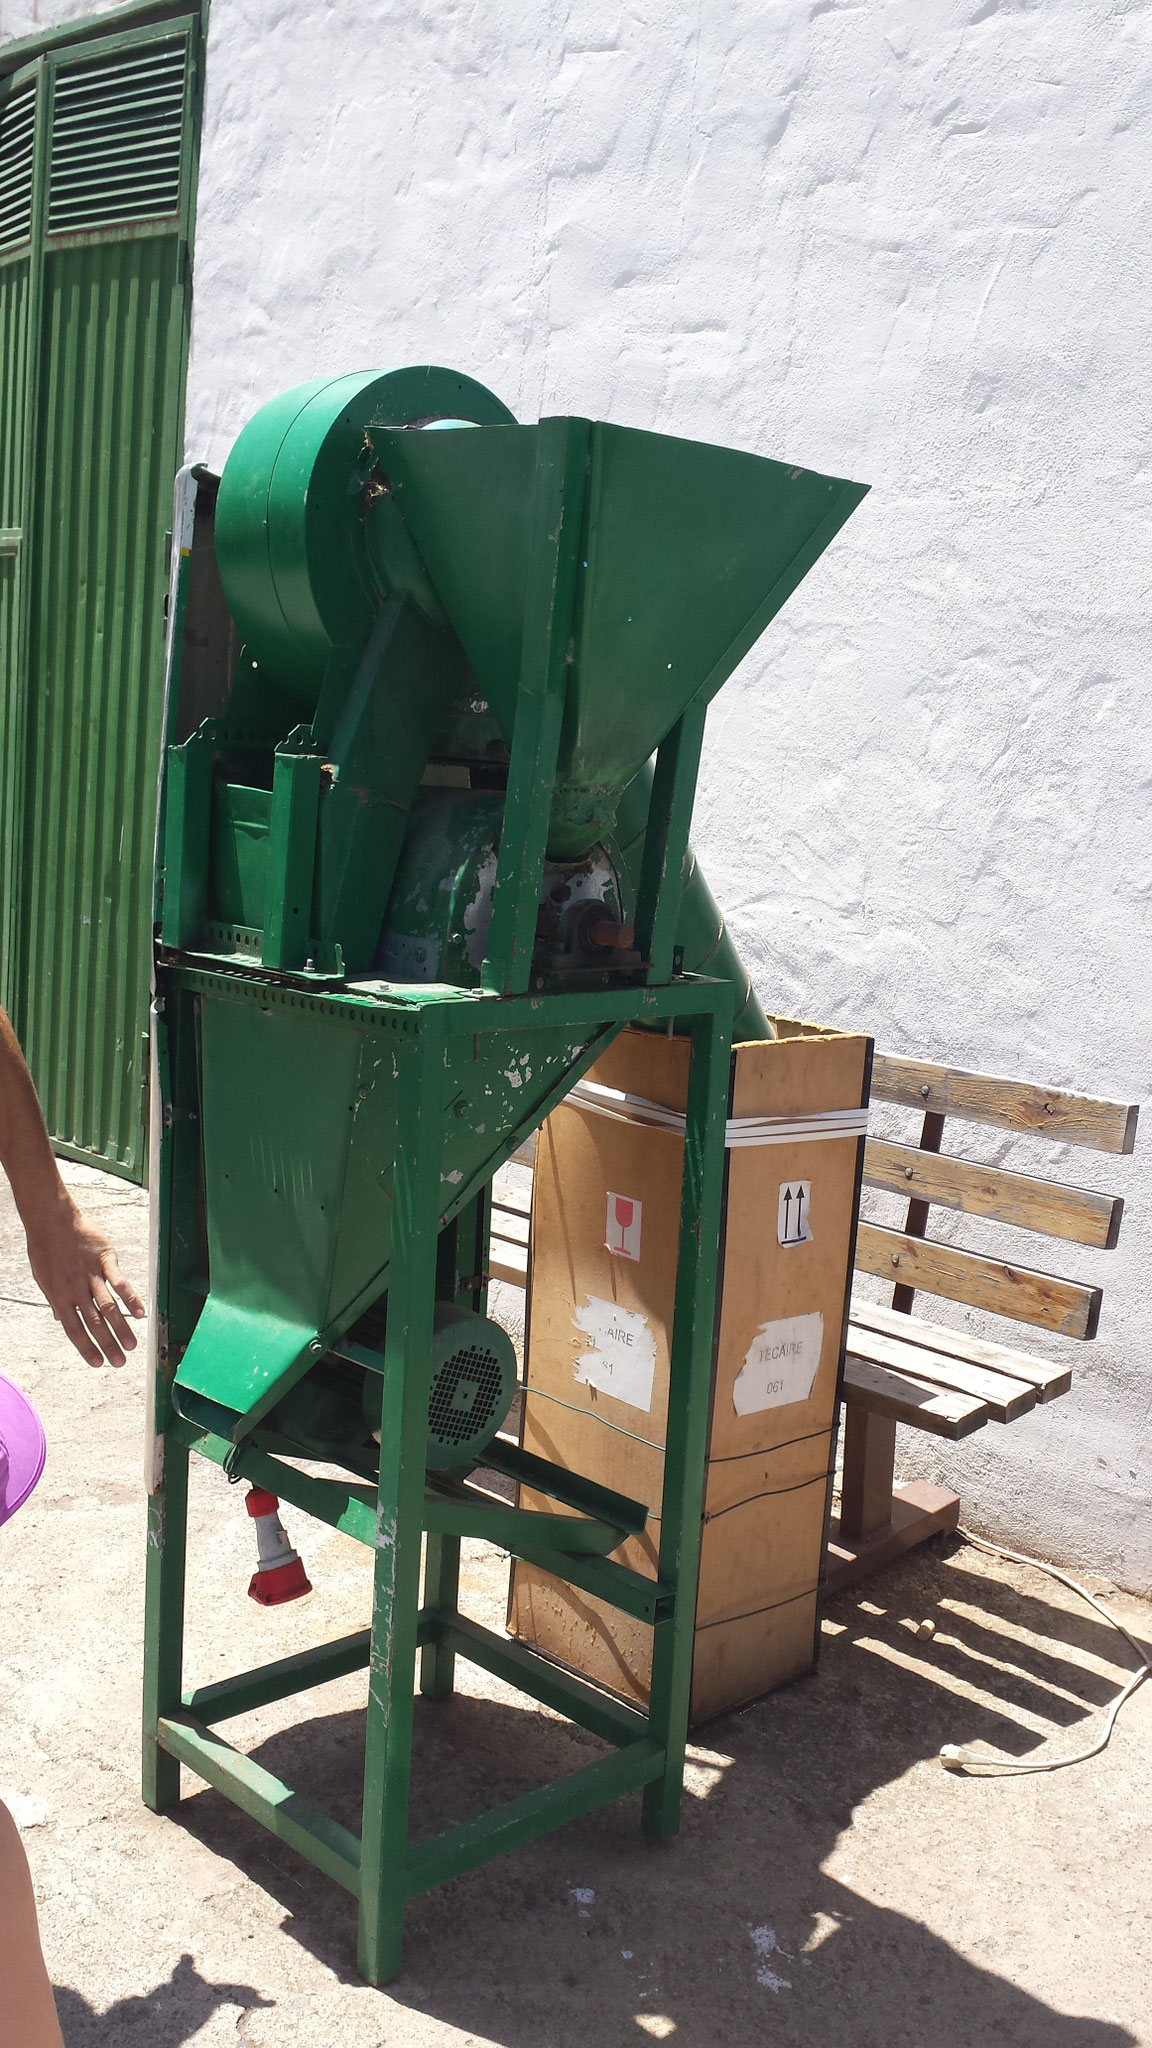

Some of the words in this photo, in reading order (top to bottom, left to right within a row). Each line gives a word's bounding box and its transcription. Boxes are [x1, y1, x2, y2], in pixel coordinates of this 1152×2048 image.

[604, 1327, 635, 1347] AIRE
[759, 1341, 803, 1363] TECAIRE
[766, 1380, 784, 1395] 061
